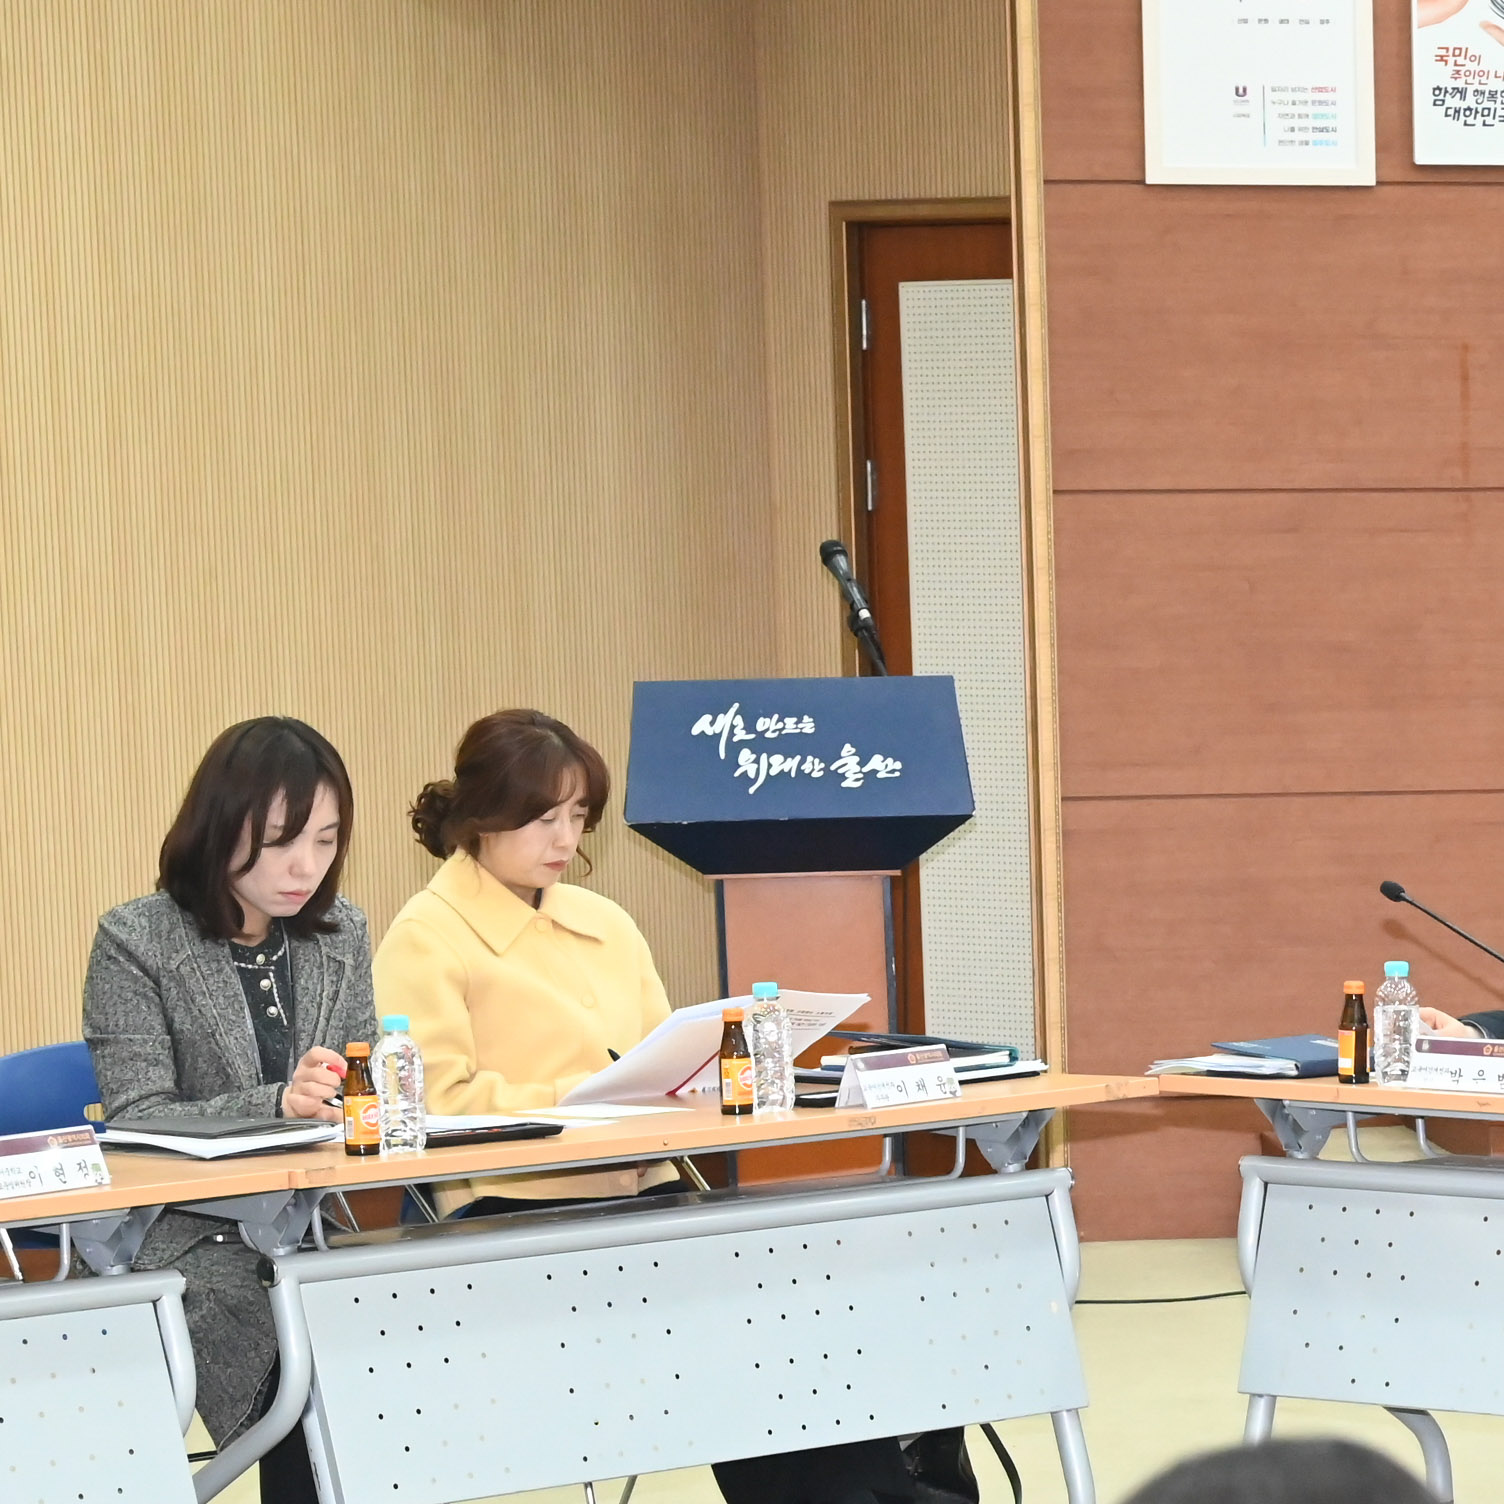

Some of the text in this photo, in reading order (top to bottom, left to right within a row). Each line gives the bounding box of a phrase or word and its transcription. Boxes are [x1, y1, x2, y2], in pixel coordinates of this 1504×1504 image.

[1434, 46, 1482, 67] 국민이
[1450, 69, 1490, 85] 주인인
[1431, 85, 1468, 107] 함께
[690, 702, 816, 760] 새로 만드는
[733, 743, 903, 795] 위대한 울산
